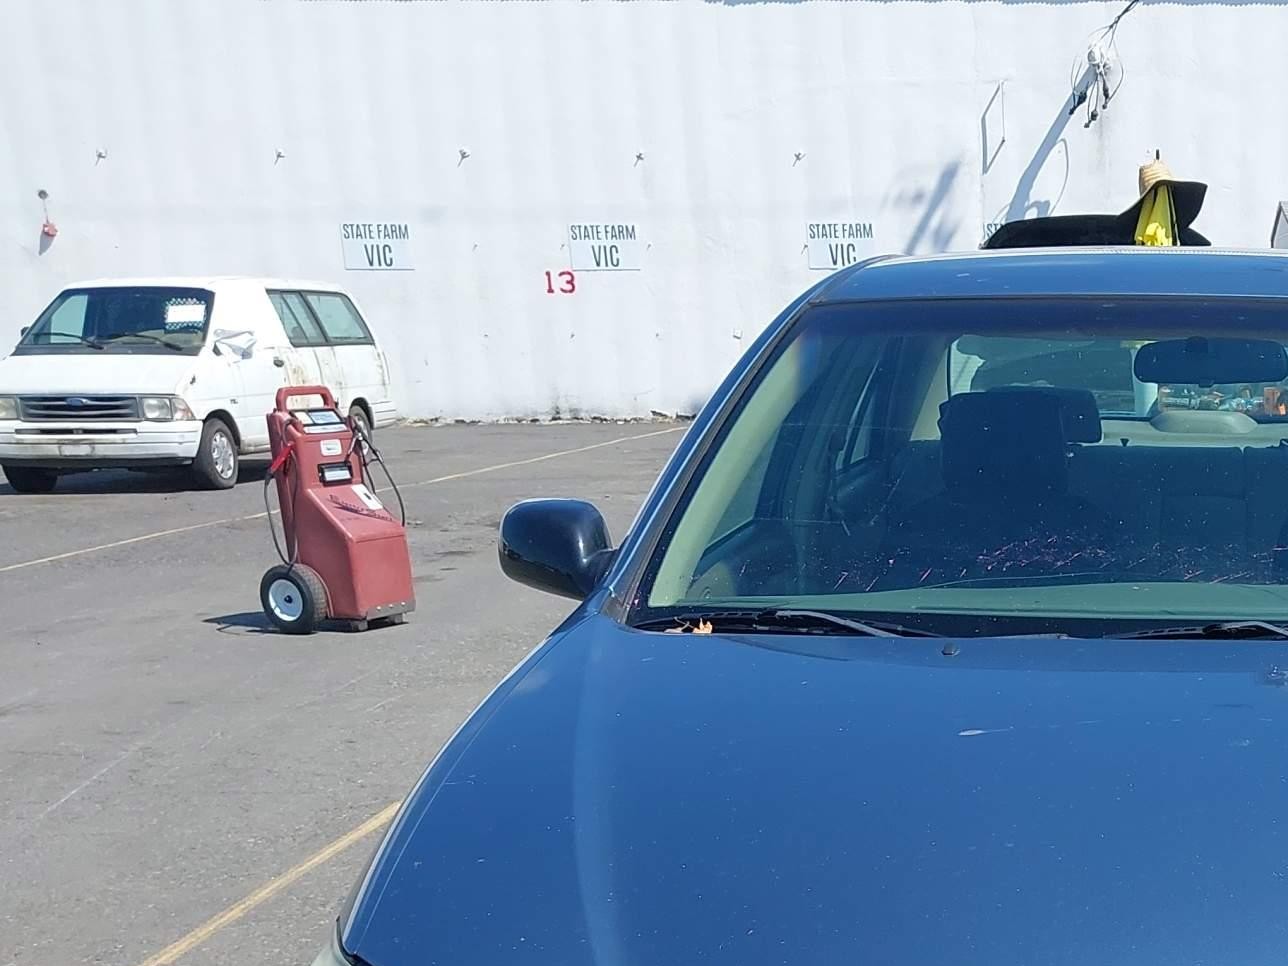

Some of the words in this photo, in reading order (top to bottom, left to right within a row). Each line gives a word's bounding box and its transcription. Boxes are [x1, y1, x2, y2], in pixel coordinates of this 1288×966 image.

[342, 223, 375, 240] STATE
[376, 223, 410, 240] FARM
[570, 224, 602, 241] STATE
[604, 224, 637, 241] FARM
[808, 223, 840, 240] STATE
[841, 223, 874, 239] FARM
[363, 243, 394, 267] VIC
[591, 244, 621, 268] VIC
[828, 243, 857, 267] VIC
[545, 270, 576, 294] 13
